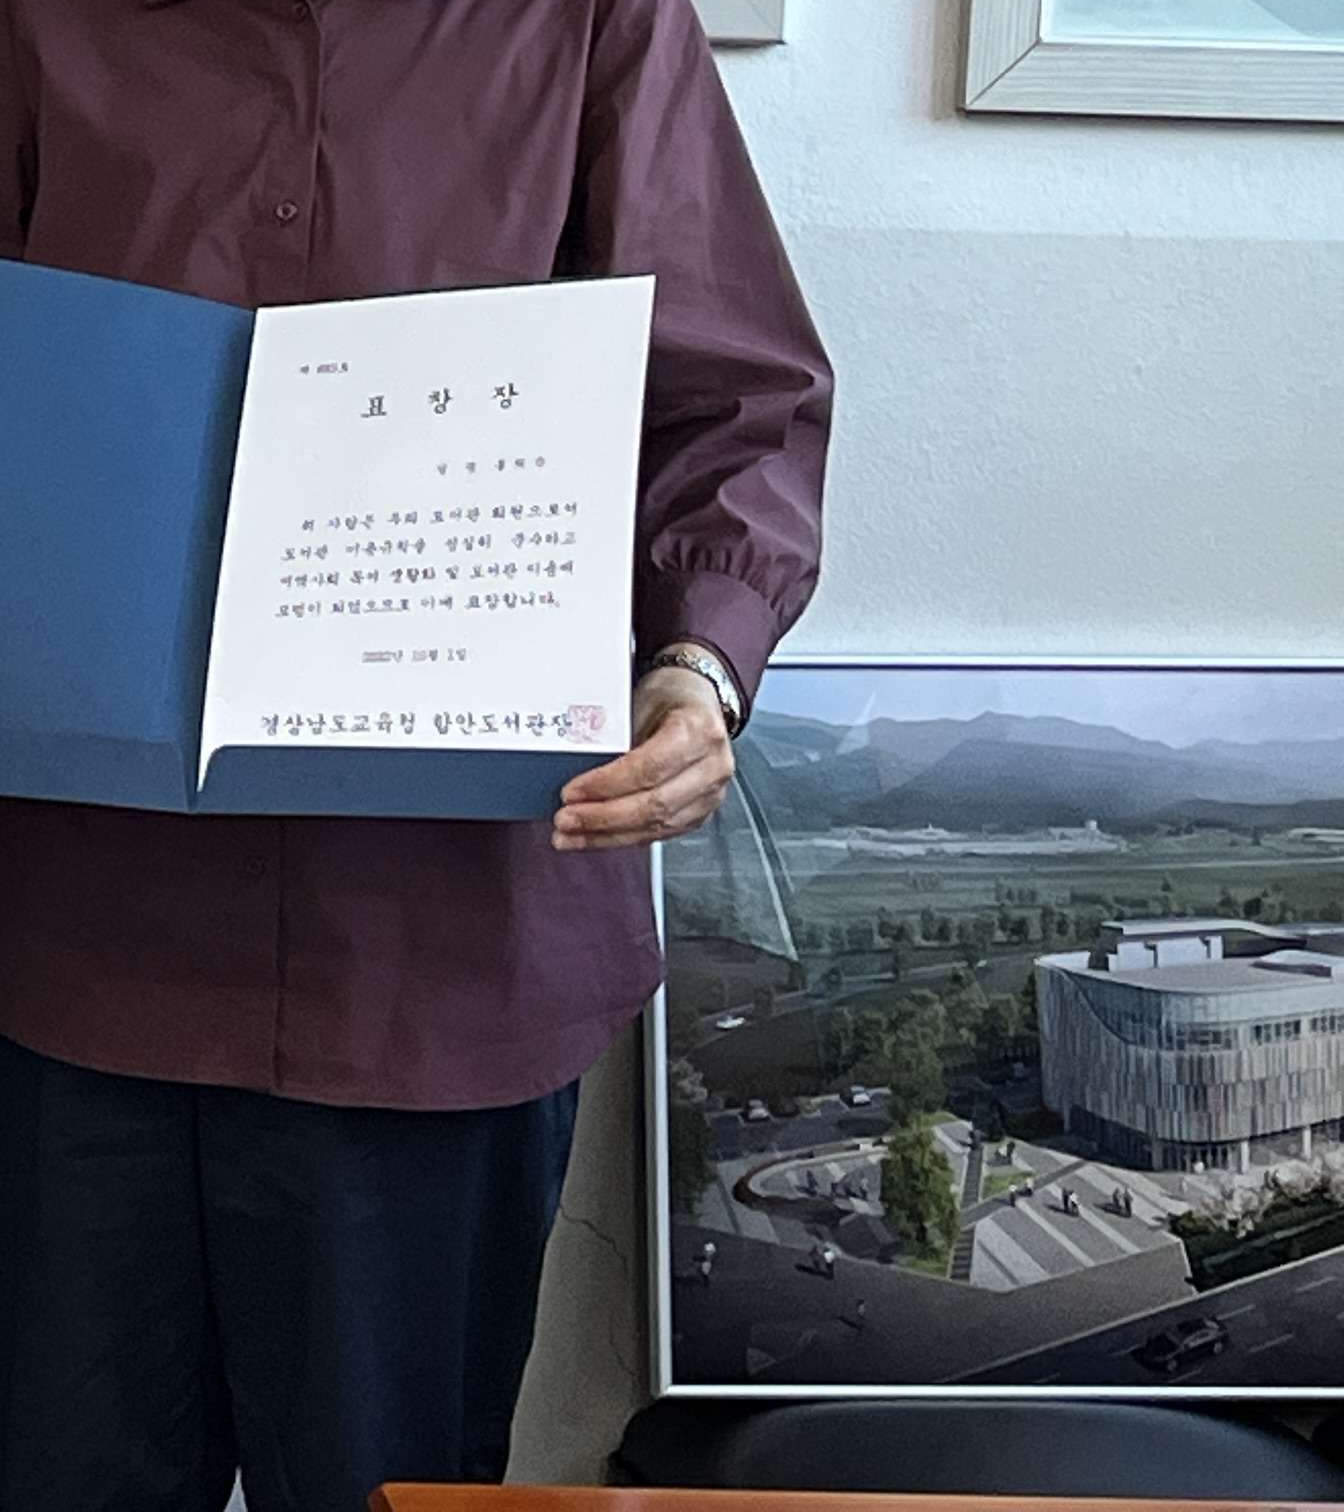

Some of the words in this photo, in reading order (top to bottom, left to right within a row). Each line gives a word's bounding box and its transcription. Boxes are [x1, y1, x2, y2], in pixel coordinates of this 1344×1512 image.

[361, 395, 387, 419] 표
[427, 388, 453, 414] 창
[491, 382, 519, 409] 장
